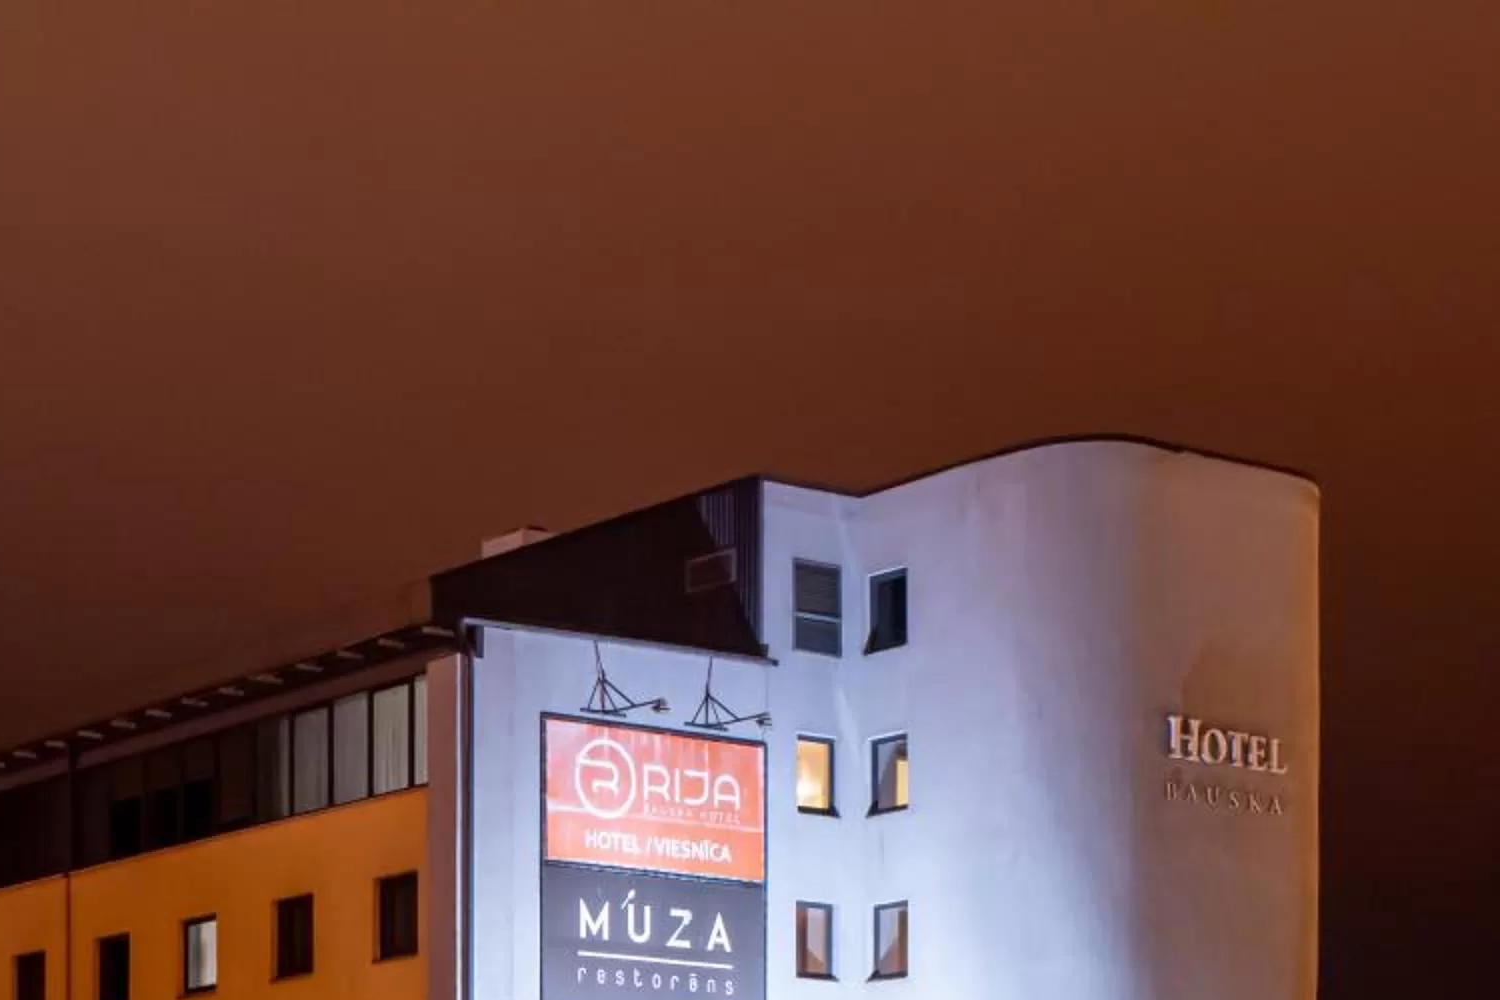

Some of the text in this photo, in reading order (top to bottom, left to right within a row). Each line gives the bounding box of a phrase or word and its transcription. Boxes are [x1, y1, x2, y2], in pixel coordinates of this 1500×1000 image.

[1167, 715, 1288, 774] HOTEL
[643, 764, 741, 811] RIJA
[1166, 783, 1283, 816] BAUSKA
[585, 828, 641, 854] HOTEL
[577, 967, 735, 996] restorāns
